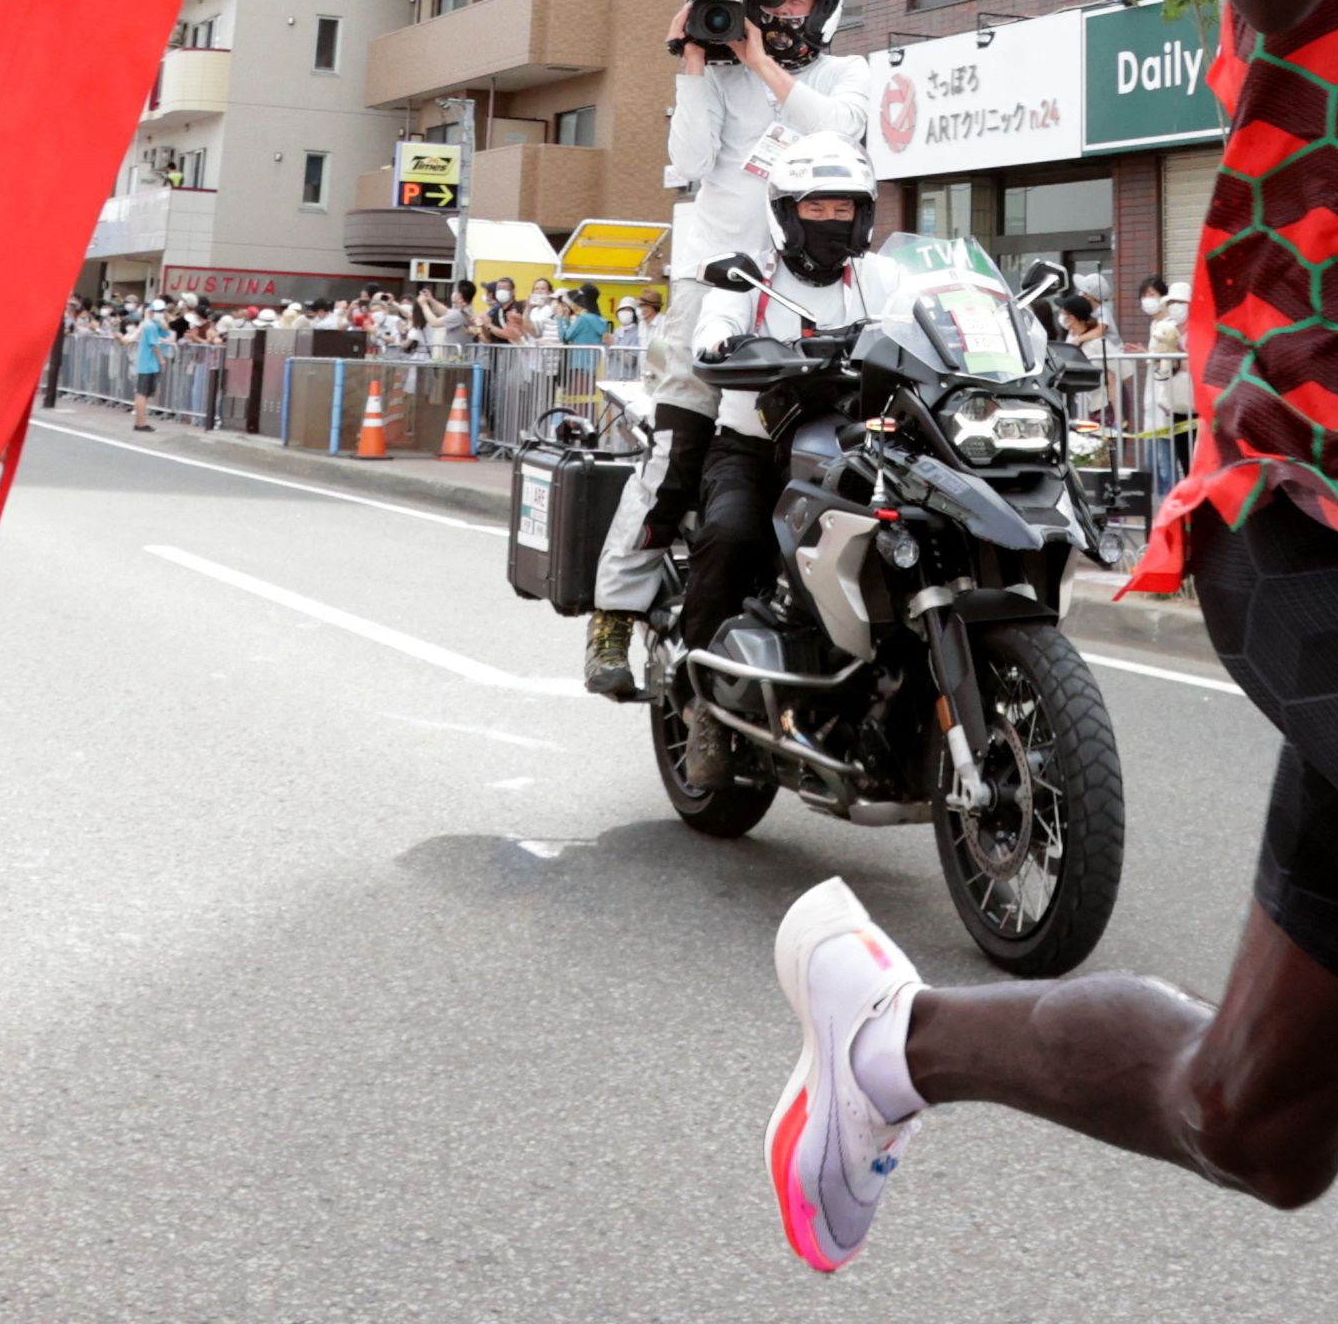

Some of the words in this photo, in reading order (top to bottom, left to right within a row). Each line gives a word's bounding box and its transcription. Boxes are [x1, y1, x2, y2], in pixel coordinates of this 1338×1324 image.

[1116, 40, 1203, 96] Daily
[925, 65, 980, 100] さっぽろ
[1029, 98, 1061, 132] n24
[412, 156, 451, 172] Times
[403, 183, 421, 205] P
[170, 276, 277, 296] JUSTINA
